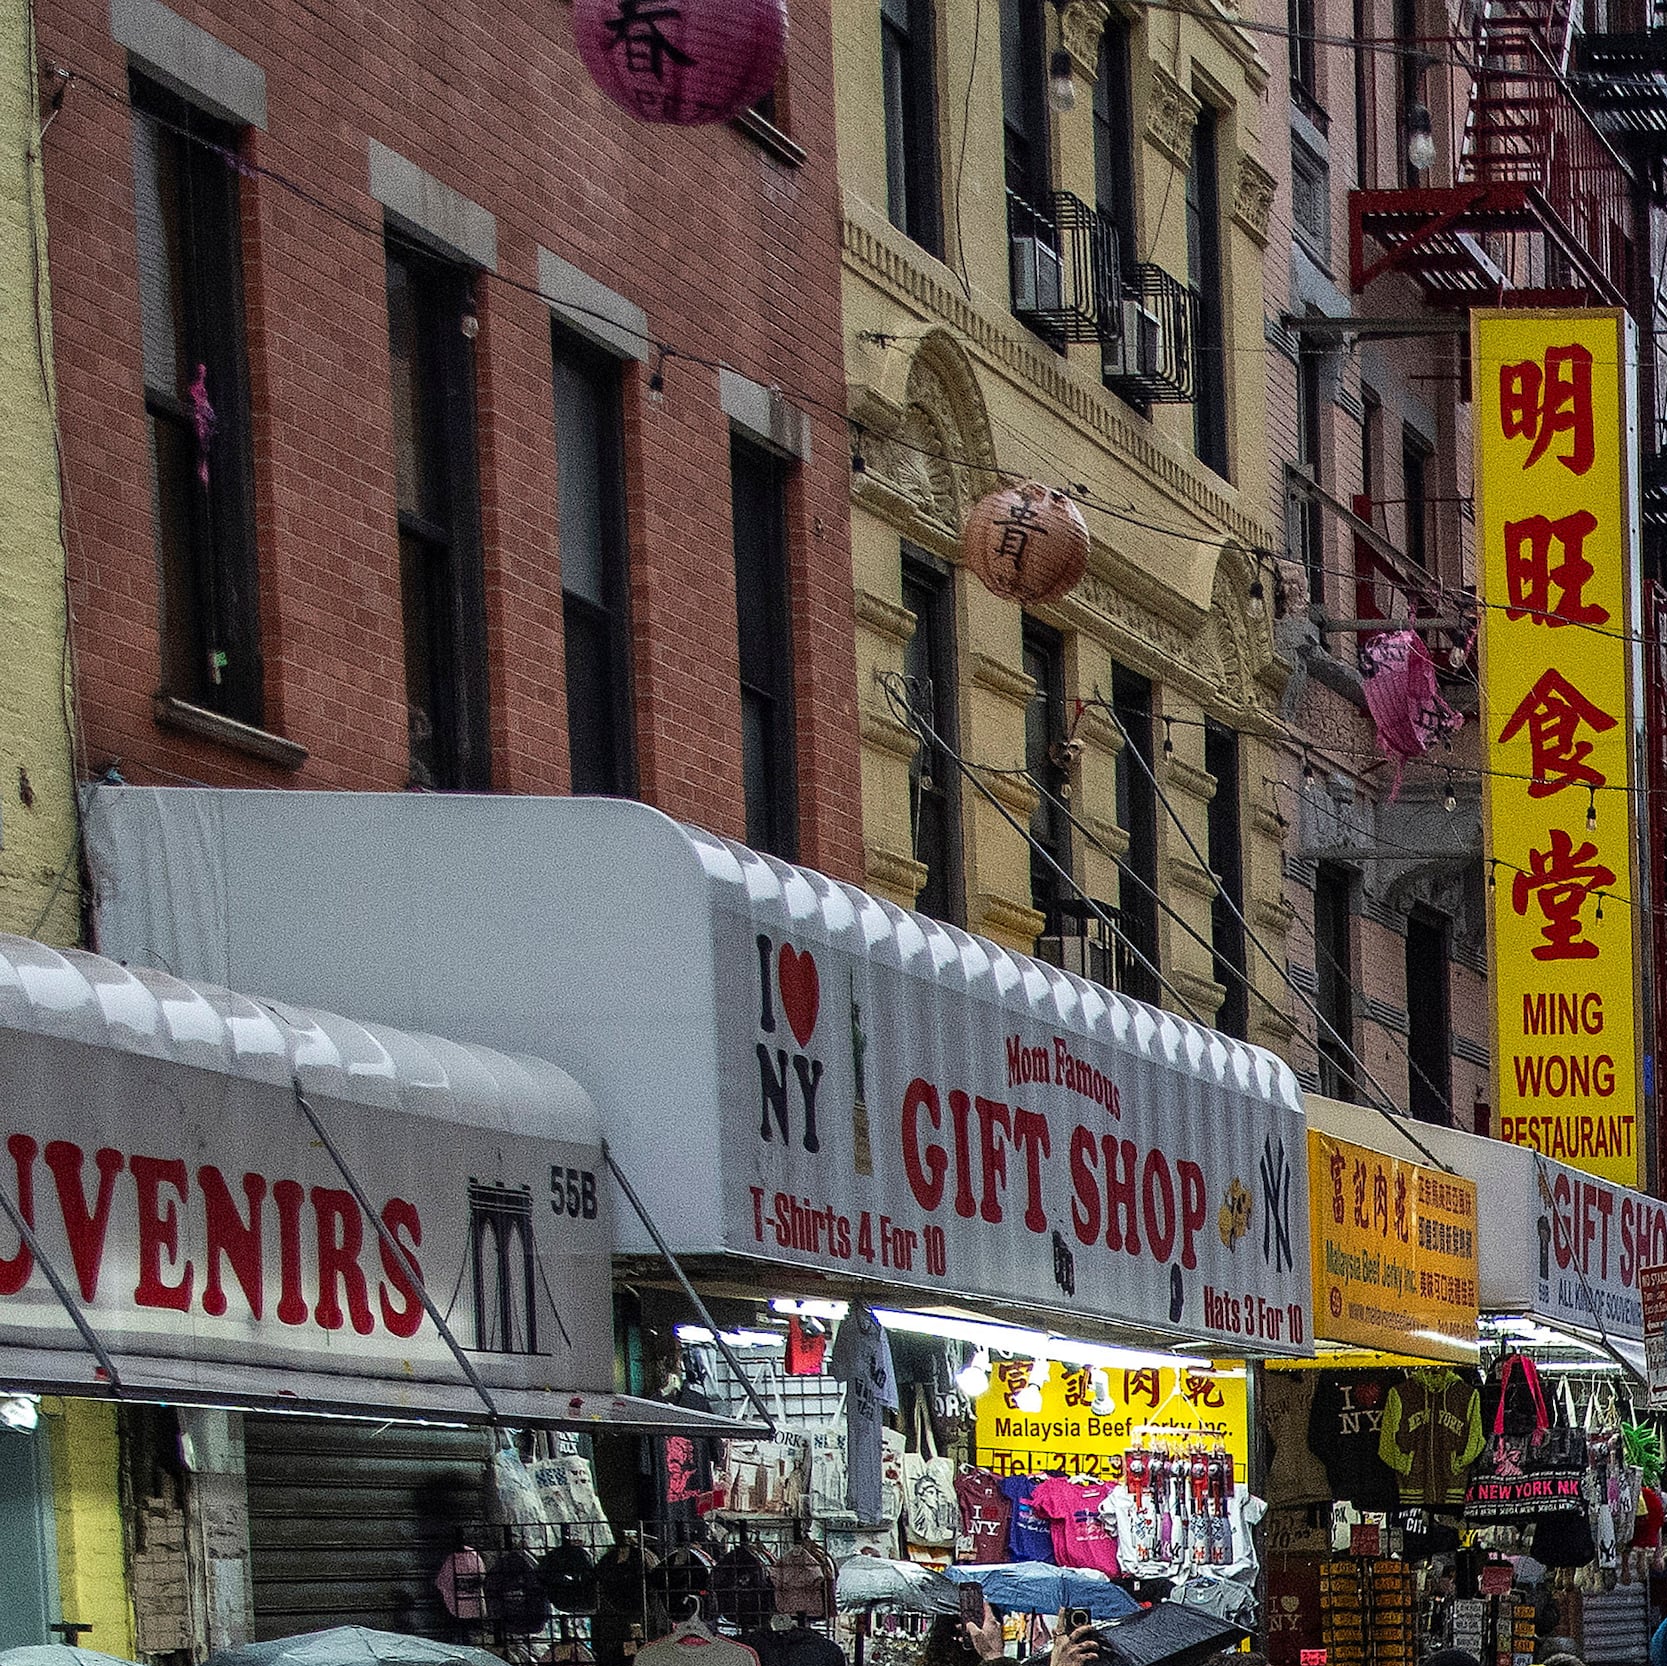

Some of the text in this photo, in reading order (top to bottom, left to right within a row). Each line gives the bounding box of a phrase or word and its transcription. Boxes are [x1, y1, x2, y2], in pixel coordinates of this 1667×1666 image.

[1498, 343, 1619, 961] 明旺食堂
[1523, 992, 1605, 1036] MING
[757, 1041, 823, 1154] NY
[1007, 1034, 1122, 1122] Mom Famous
[1513, 1054, 1616, 1098] WONG
[1501, 1116, 1635, 1159] RESTAURANT
[550, 1165, 598, 1221] 55B
[901, 1077, 1208, 1271] GIFT SHOP
[749, 1184, 947, 1278] T-Shirts 4 For 10
[1552, 1172, 1614, 1282] GIFT
[1202, 1283, 1242, 1336] Hats
[1244, 1291, 1256, 1334] 3
[1258, 1297, 1284, 1341] For
[1287, 1302, 1304, 1346] 10
[1339, 1386, 1352, 1411] I
[775, 1430, 803, 1449] ORK
[995, 1417, 1081, 1442] Malaysia
[1088, 1416, 1133, 1437] Beef
[1437, 1411, 1465, 1436] YORK
[1478, 1484, 1512, 1501] NEW
[1515, 1480, 1553, 1499] YORK
[968, 1518, 1000, 1536] NY
